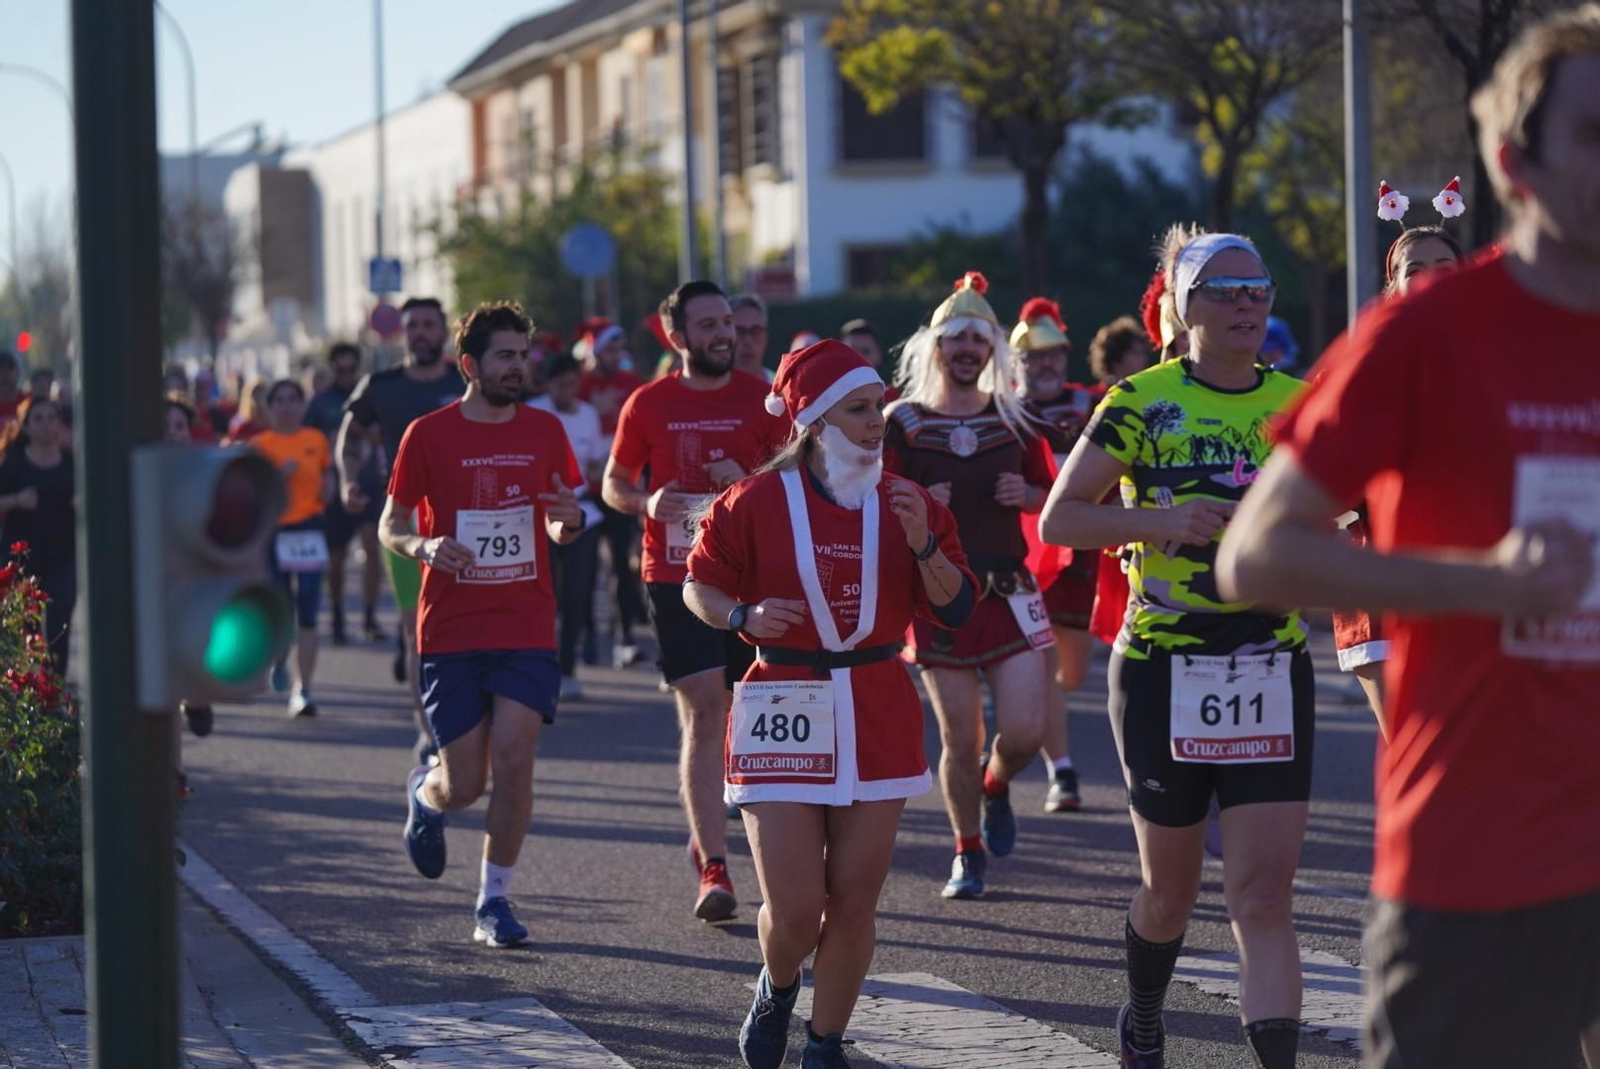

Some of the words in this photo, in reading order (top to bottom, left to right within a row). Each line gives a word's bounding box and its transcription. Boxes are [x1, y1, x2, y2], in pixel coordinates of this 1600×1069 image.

[709, 448, 724, 460] 50
[506, 484, 520, 497] 50
[476, 535, 521, 558] 793
[813, 544, 831, 555] VII
[464, 566, 523, 579] Cruzcampo
[842, 584, 860, 597] 50
[1200, 692, 1264, 726] 611
[750, 713, 811, 743] 480
[1182, 739, 1271, 757] Cruzcampo
[738, 755, 814, 771] Cruzcampo
